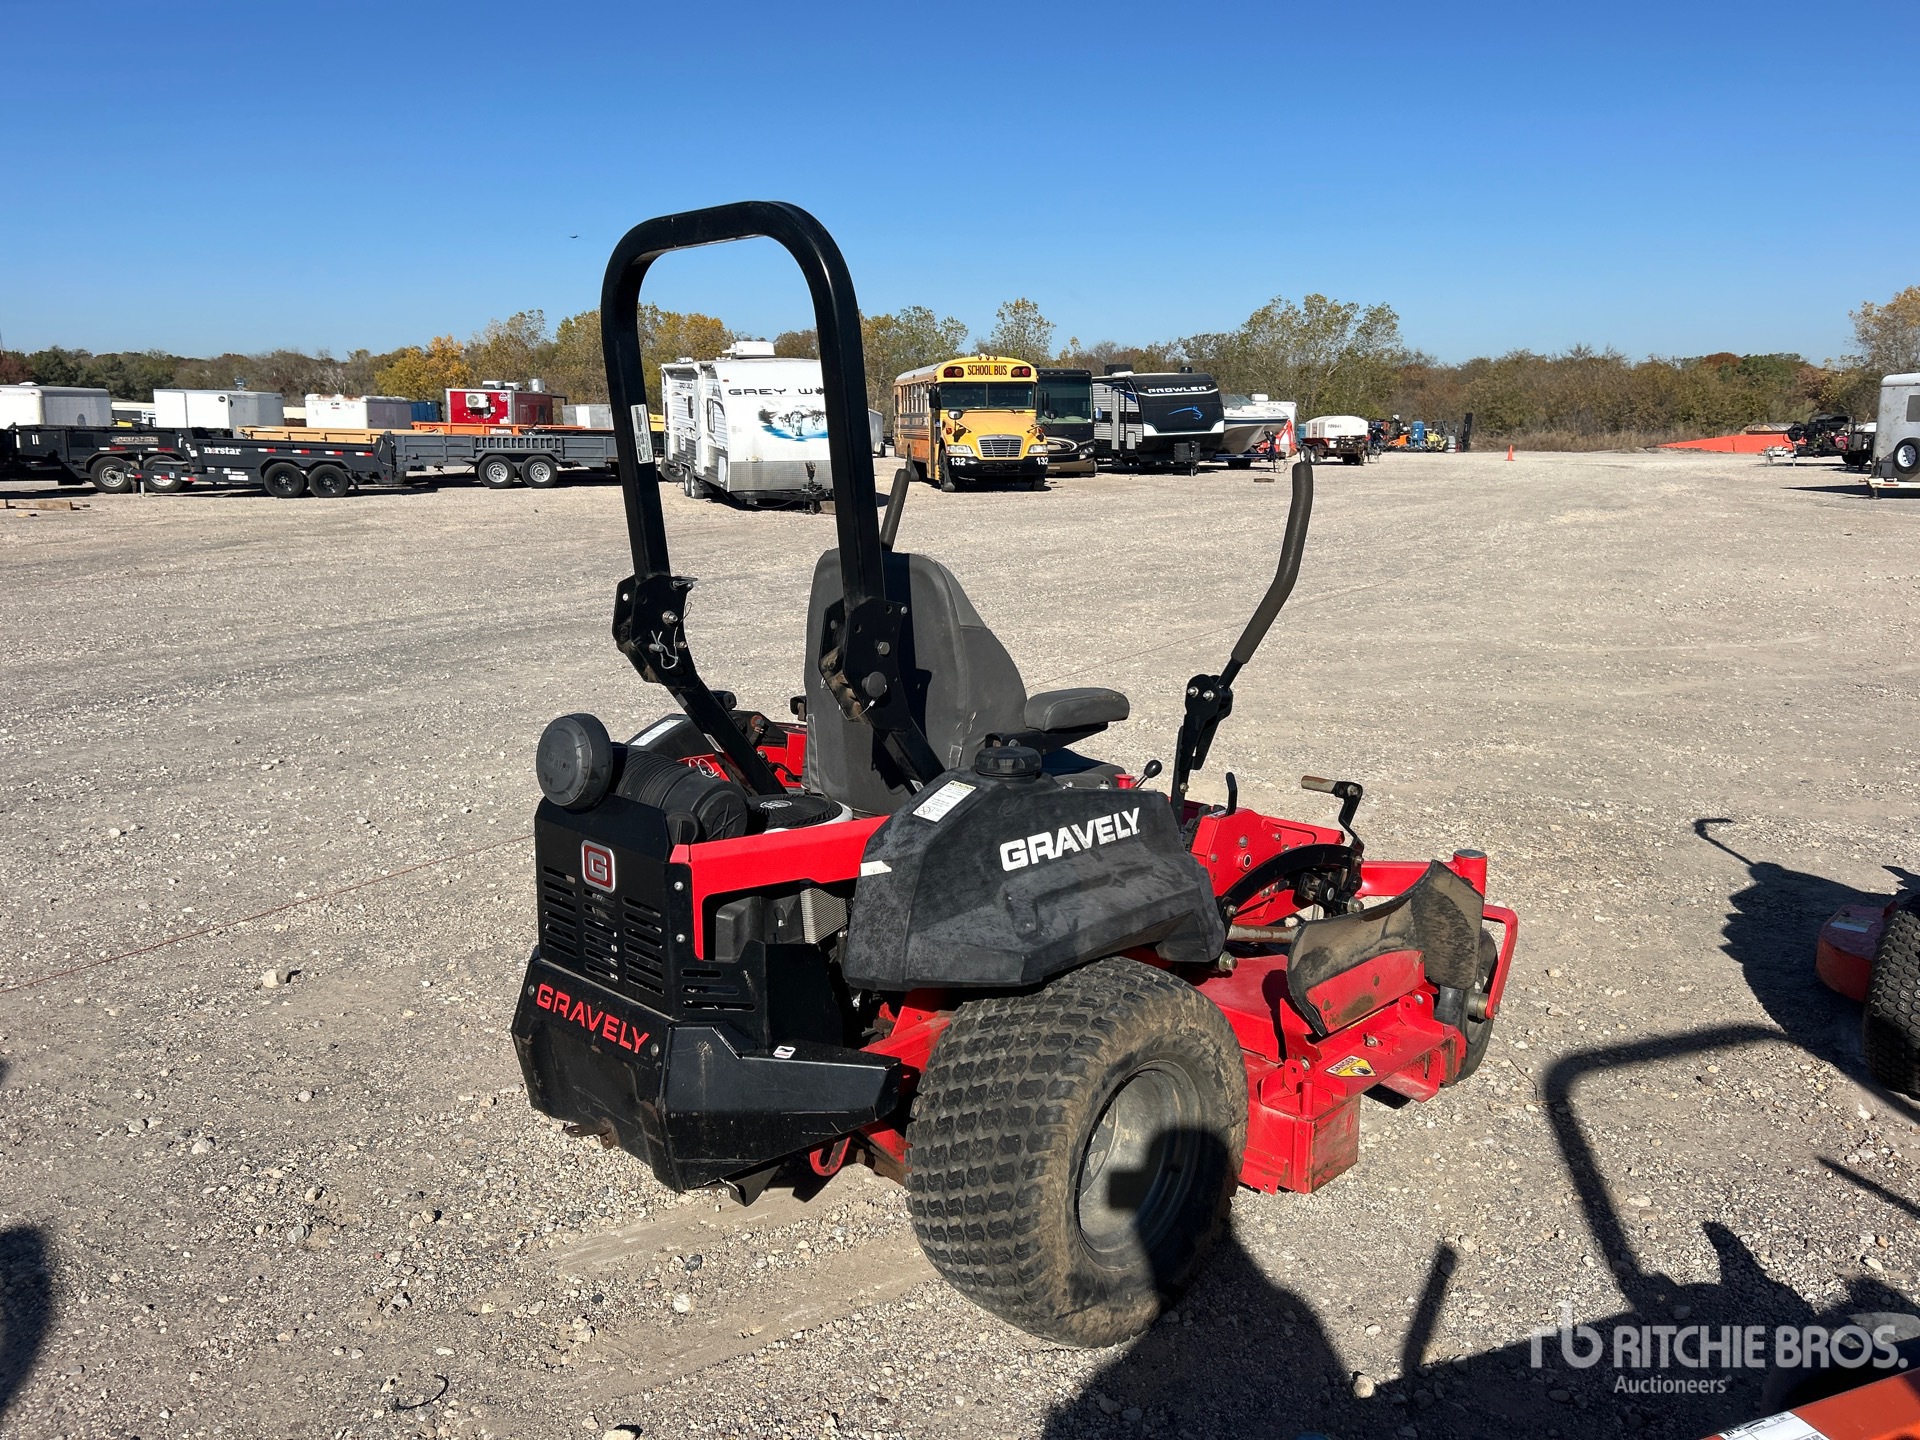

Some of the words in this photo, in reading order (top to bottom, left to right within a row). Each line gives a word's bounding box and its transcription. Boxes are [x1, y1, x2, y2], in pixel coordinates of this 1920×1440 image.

[967, 365, 993, 376] SCHOOL
[994, 365, 1008, 376] BUS
[728, 388, 787, 396] GREY
[1147, 386, 1207, 394] PROWLER
[950, 457, 966, 466] 132
[1036, 457, 1049, 465] 132
[999, 807, 1141, 872] GRAVELY
[536, 983, 650, 1054] GRAVELY
